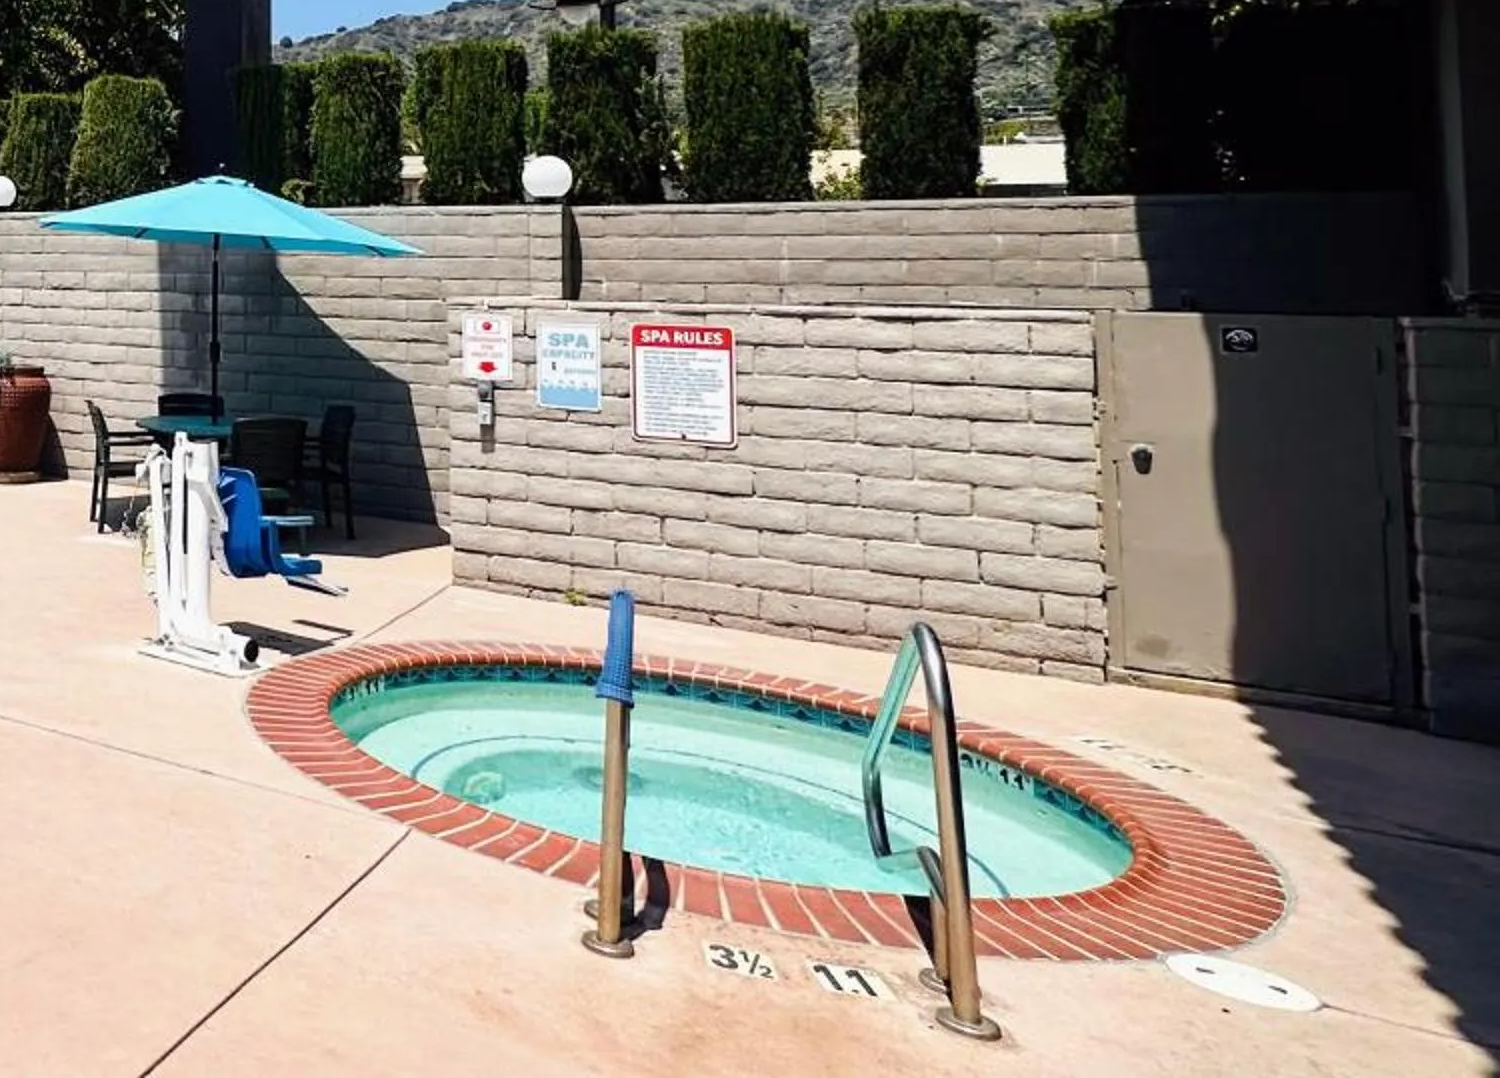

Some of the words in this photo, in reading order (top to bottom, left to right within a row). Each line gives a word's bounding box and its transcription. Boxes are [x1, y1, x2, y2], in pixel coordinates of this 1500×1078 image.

[547, 332, 590, 349] SPA
[641, 329, 670, 343] SPA
[673, 331, 724, 346] RULES
